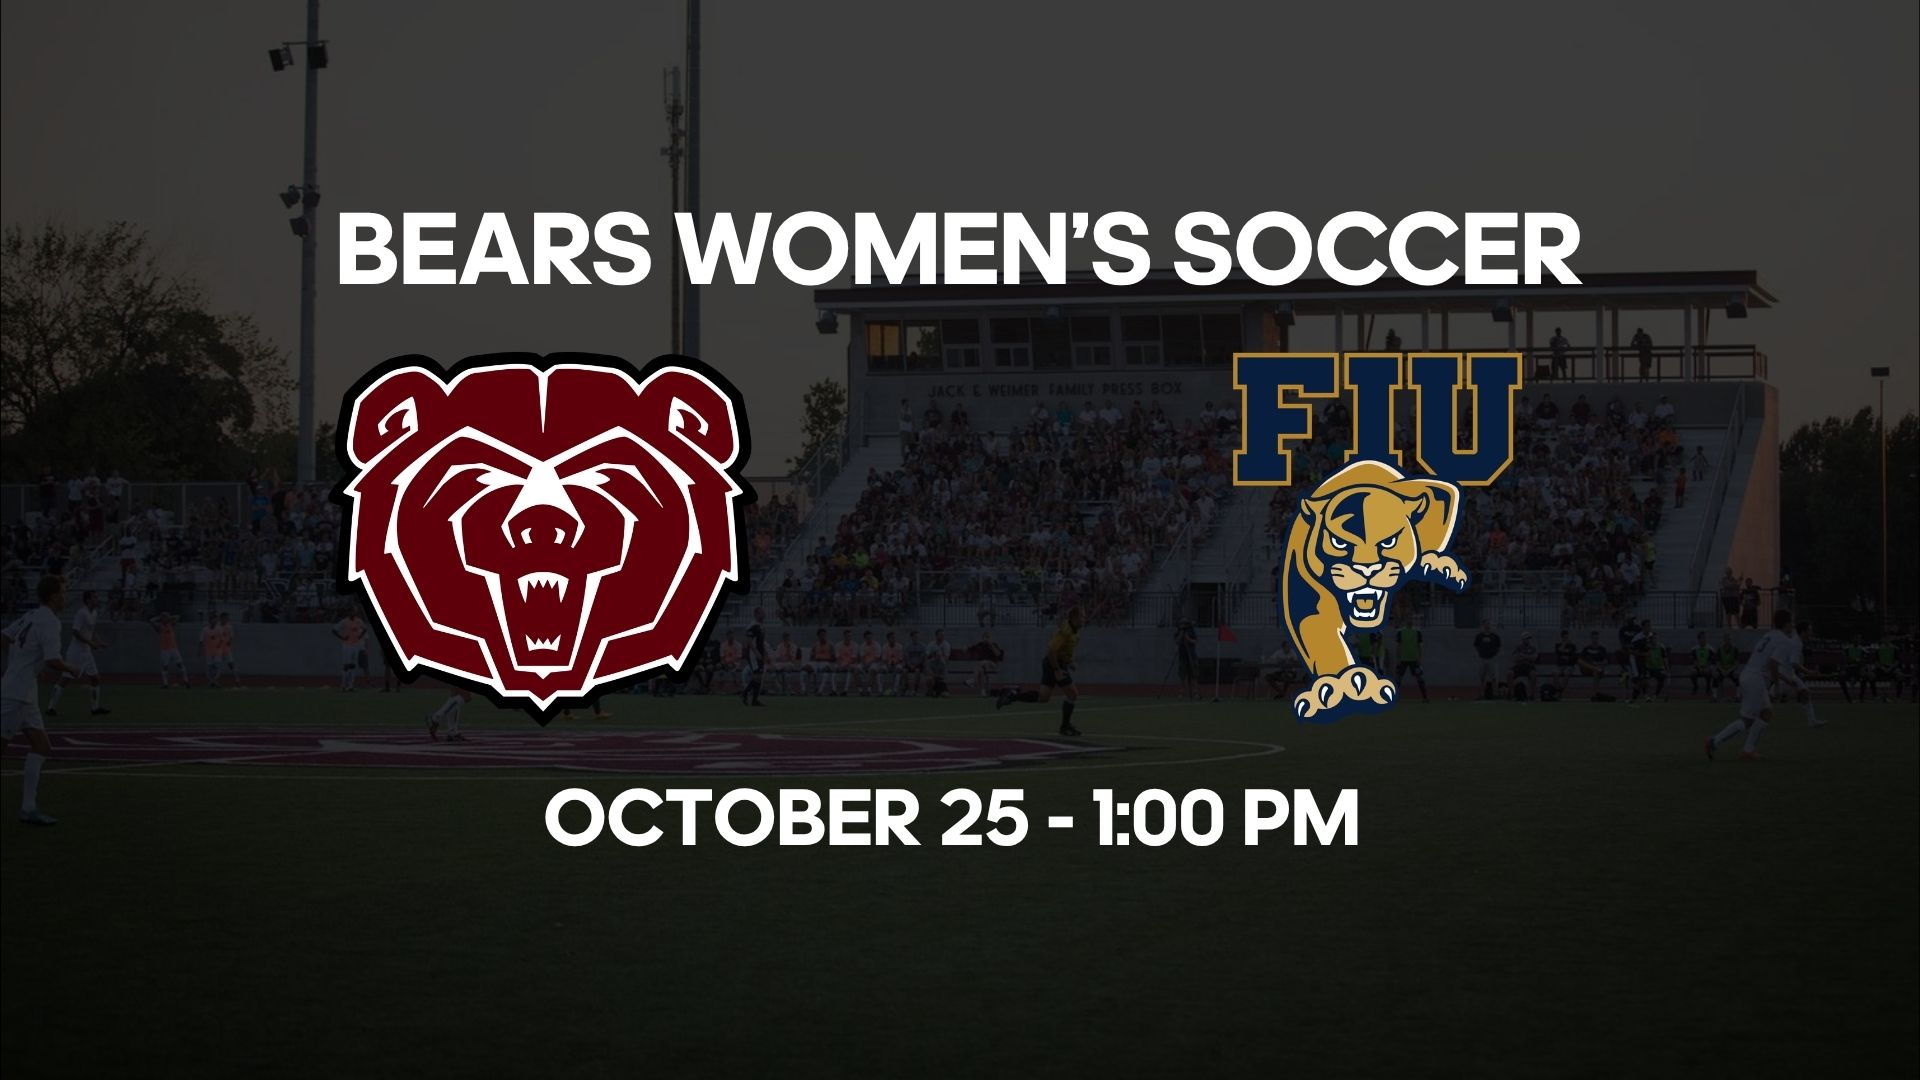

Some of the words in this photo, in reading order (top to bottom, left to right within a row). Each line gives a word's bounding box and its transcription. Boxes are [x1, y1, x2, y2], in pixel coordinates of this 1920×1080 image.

[928, 384, 966, 399] JACK
[988, 382, 1040, 397] WEIMER
[1048, 382, 1096, 396] FAMILY
[1101, 381, 1144, 396] PRESS
[1150, 381, 1183, 395] BOX
